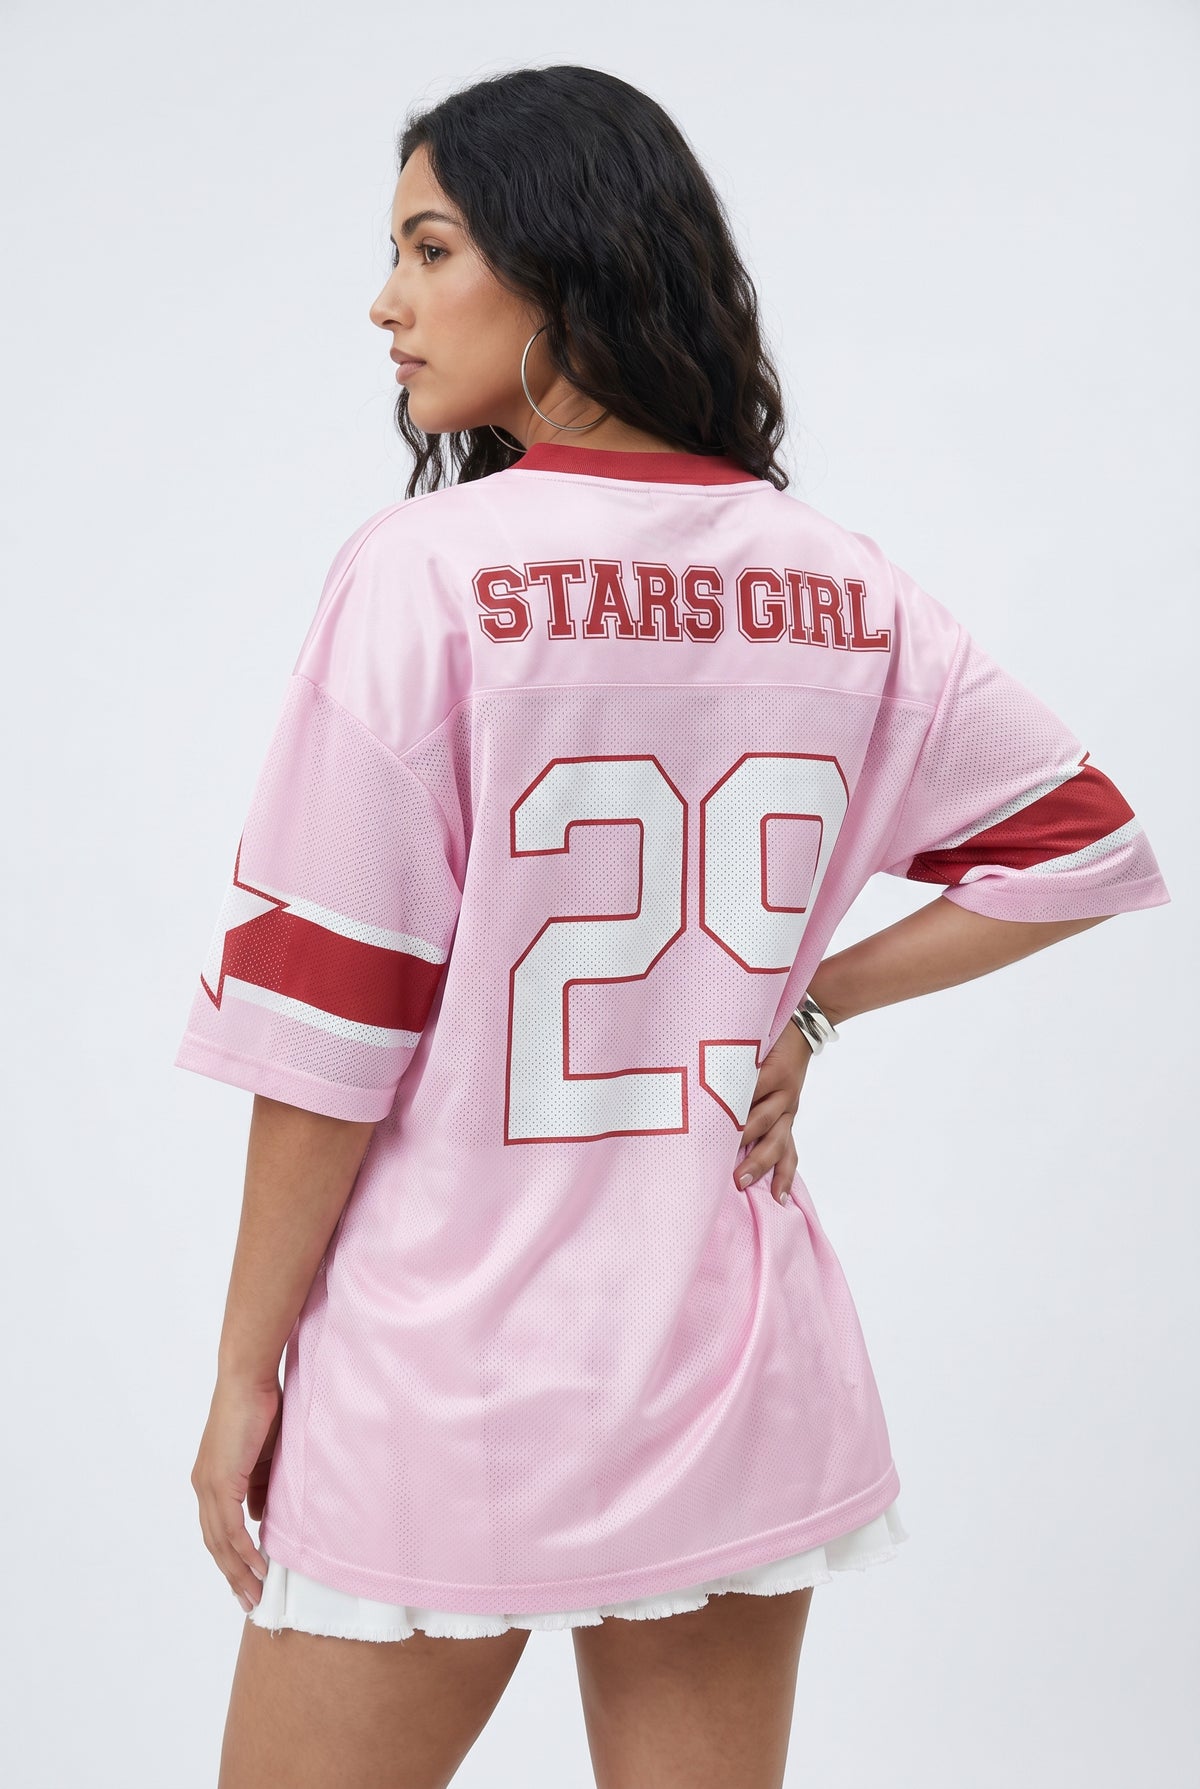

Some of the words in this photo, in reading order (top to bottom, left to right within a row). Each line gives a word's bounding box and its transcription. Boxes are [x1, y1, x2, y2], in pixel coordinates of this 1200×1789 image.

[472, 558, 724, 643] STARS
[736, 567, 891, 653] GIRL
[504, 752, 849, 1146] 29
